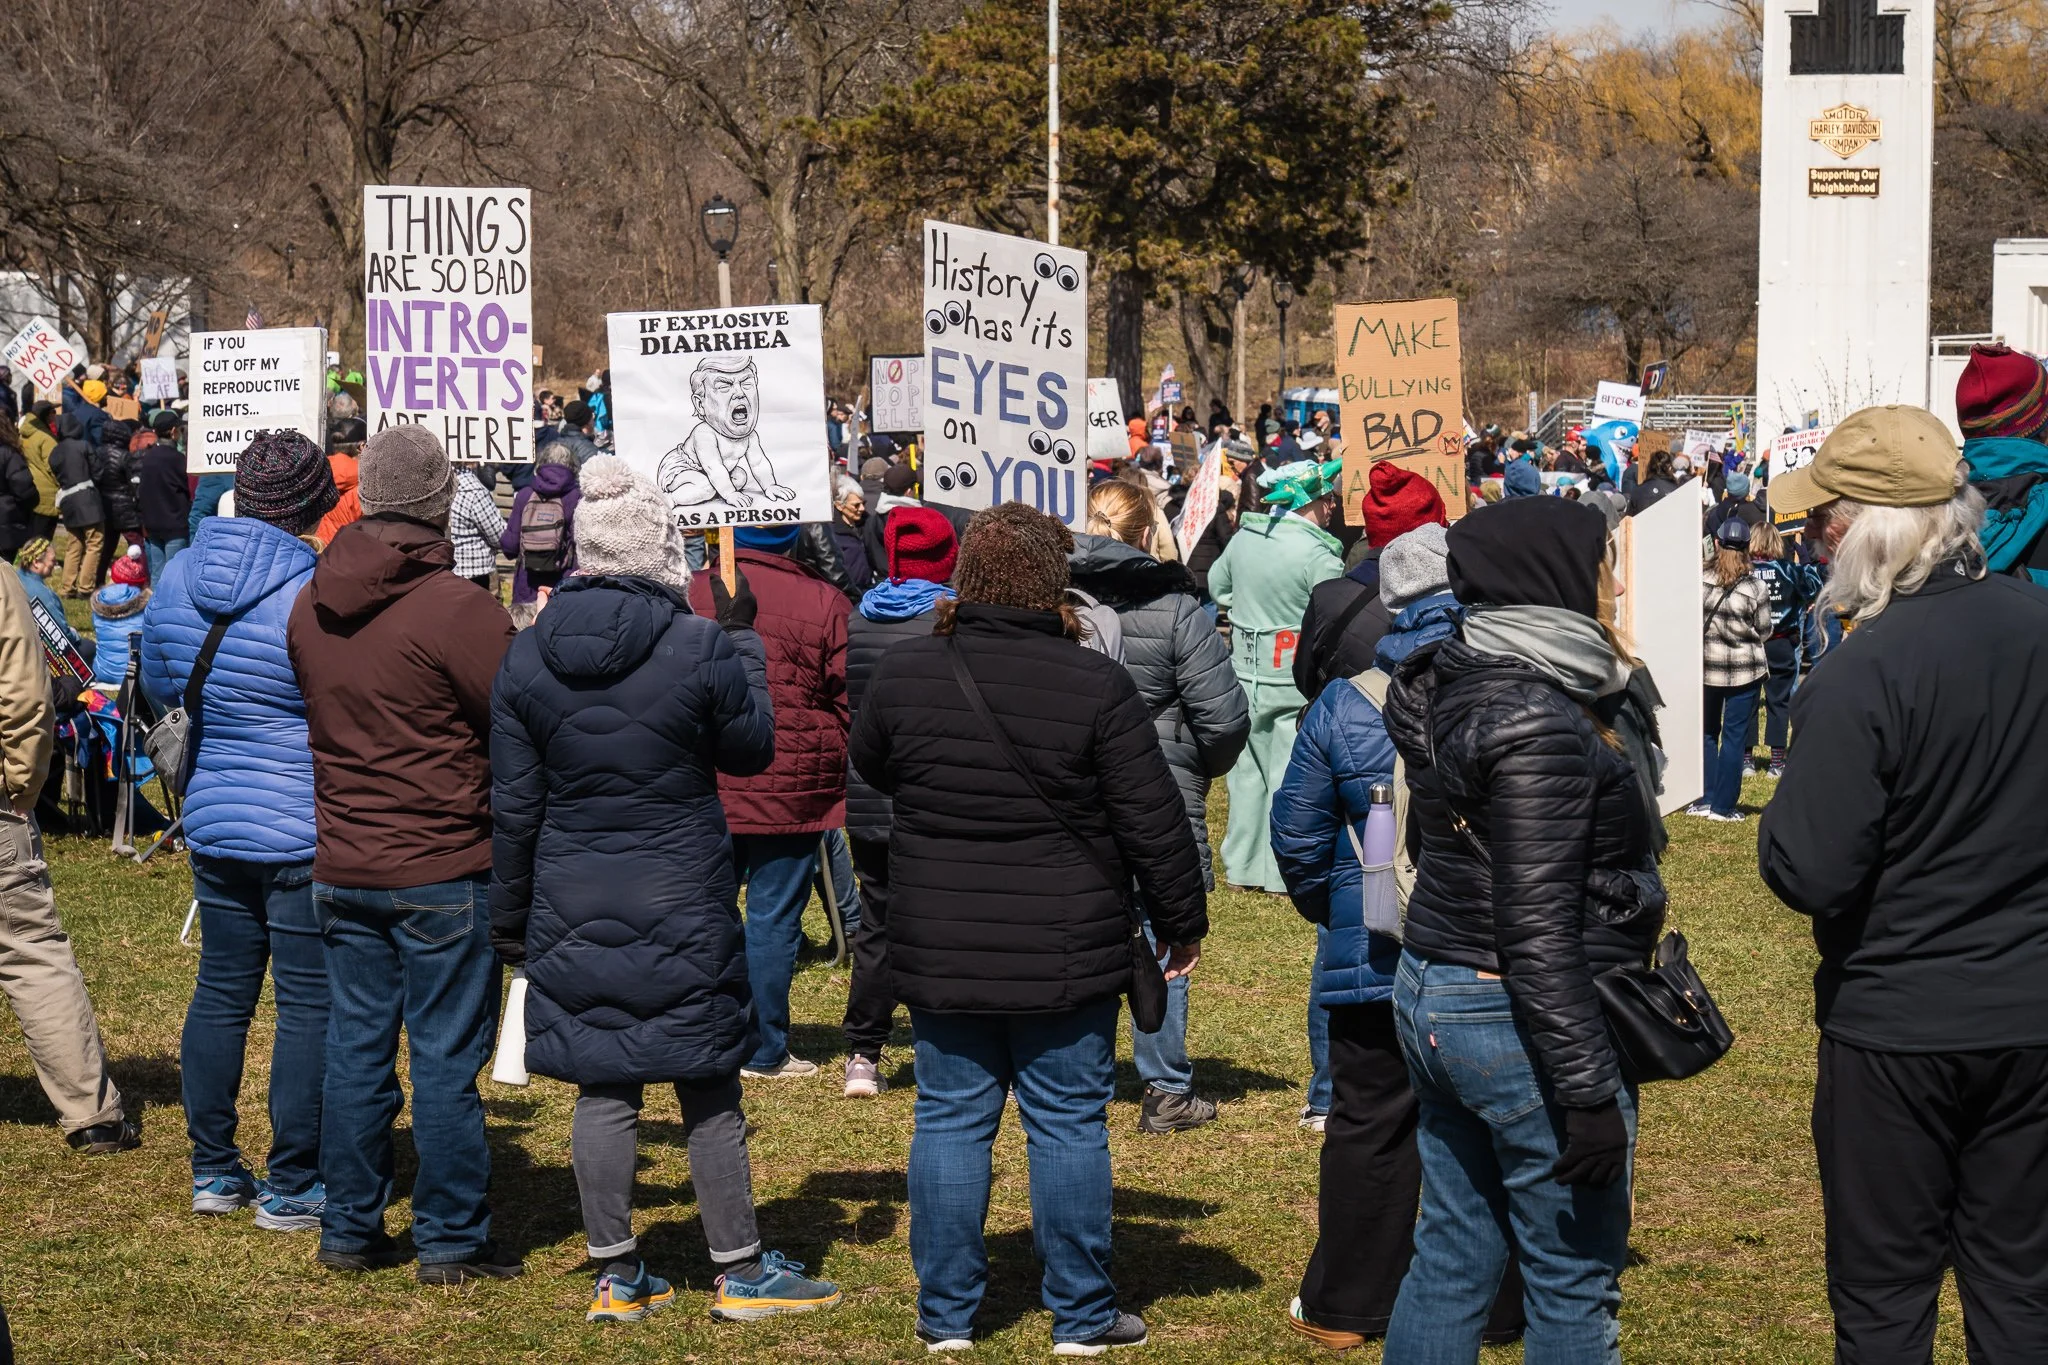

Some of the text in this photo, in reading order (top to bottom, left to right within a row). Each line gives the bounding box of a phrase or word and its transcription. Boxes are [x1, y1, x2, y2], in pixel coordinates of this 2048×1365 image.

[1829, 108, 1863, 120] MOTOR
[1814, 124, 1877, 134] HARLEY-DAVIDSON
[1828, 139, 1862, 152] COMPANY
[1810, 169, 1879, 182] Supporting Our
[1812, 182, 1876, 195] Neighborhood
[375, 194, 527, 257] THINGS
[367, 252, 527, 296] ARE SO BAD
[931, 228, 1039, 328] History
[368, 299, 528, 355] INTRO-
[639, 311, 790, 334] IF EXPLOSIVE
[964, 299, 1072, 350] has its
[6, 321, 42, 358] HOT TAKE
[203, 336, 245, 350] IF YOU
[640, 329, 791, 356] DIARRHEA
[1347, 316, 1451, 357] MAKE
[15, 332, 55, 369] WAR
[33, 349, 74, 390] BAD
[203, 358, 280, 372] CUT OFF MY
[203, 379, 300, 394] REPRODUCTIVE
[368, 355, 527, 412] VERTS
[931, 346, 1069, 431] EYES
[1341, 373, 1451, 403] BULLYING
[203, 404, 259, 417] RIGHTS...
[1601, 394, 1638, 408] BITCHES
[943, 418, 977, 445] on
[1089, 410, 1120, 428] GER
[1362, 408, 1443, 451] BAD
[206, 430, 232, 443] CAN
[236, 430, 240, 442] I
[444, 416, 528, 461] HERE
[1778, 436, 1794, 444] STOP
[1796, 432, 1819, 440] TRUMP
[1791, 437, 1827, 448] OLIGARCH
[981, 450, 1075, 526] YOU
[673, 507, 801, 527] AS A PERSON
[1775, 510, 1808, 525] BILLIONAI
[1762, 569, 1776, 579] HATE
[32, 604, 68, 651] HANDS
[1273, 630, 1300, 668] P
[727, 1285, 758, 1299] HOKA
